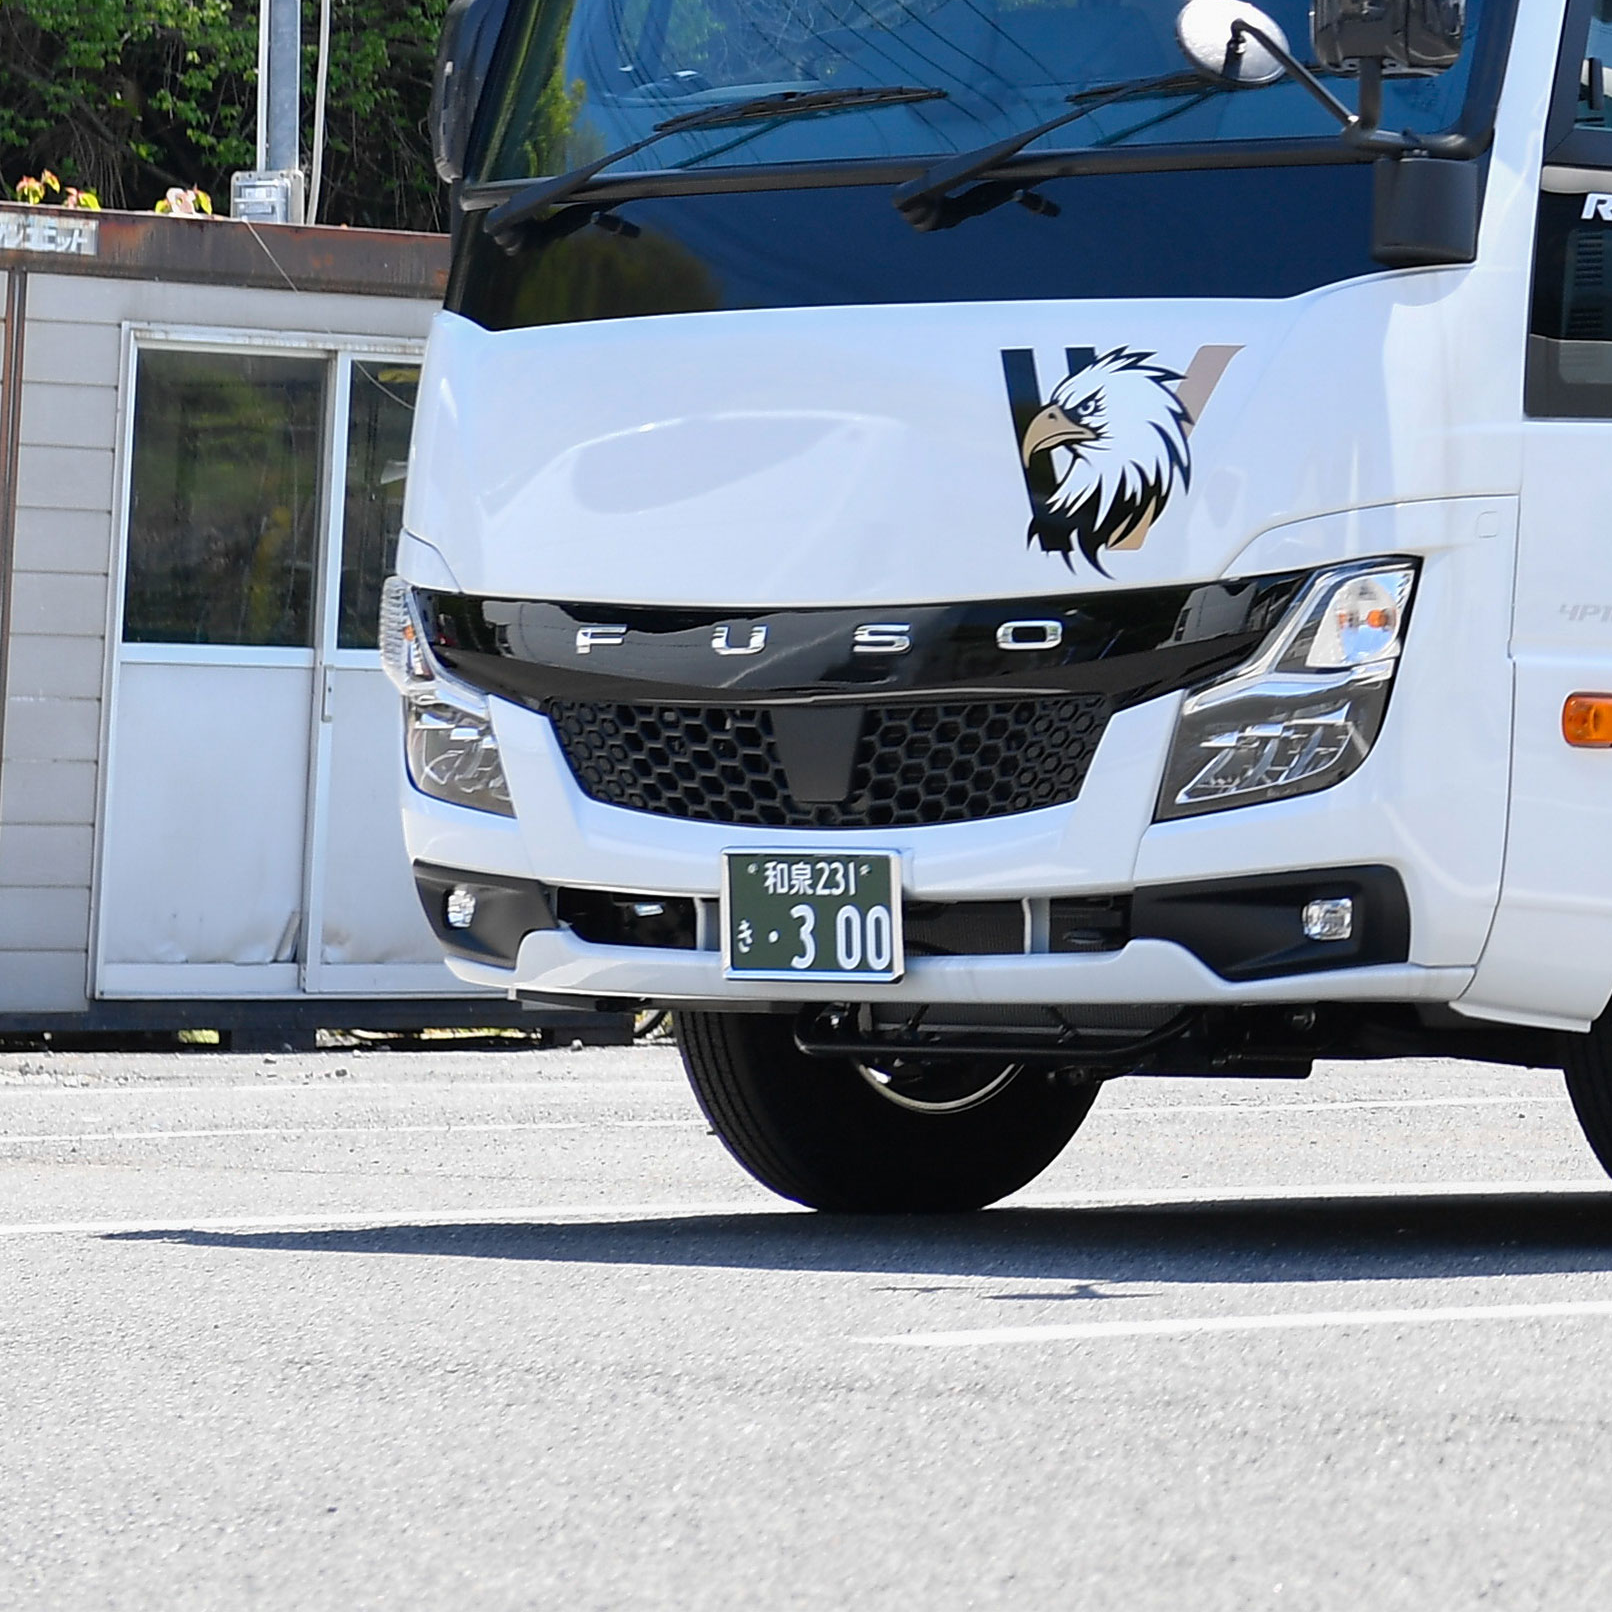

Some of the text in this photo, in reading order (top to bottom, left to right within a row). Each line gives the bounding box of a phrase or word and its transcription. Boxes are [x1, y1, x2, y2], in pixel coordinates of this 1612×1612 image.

[575, 618, 1064, 655] FUSO
[763, 861, 857, 896] 和泉231
[737, 919, 753, 953] き
